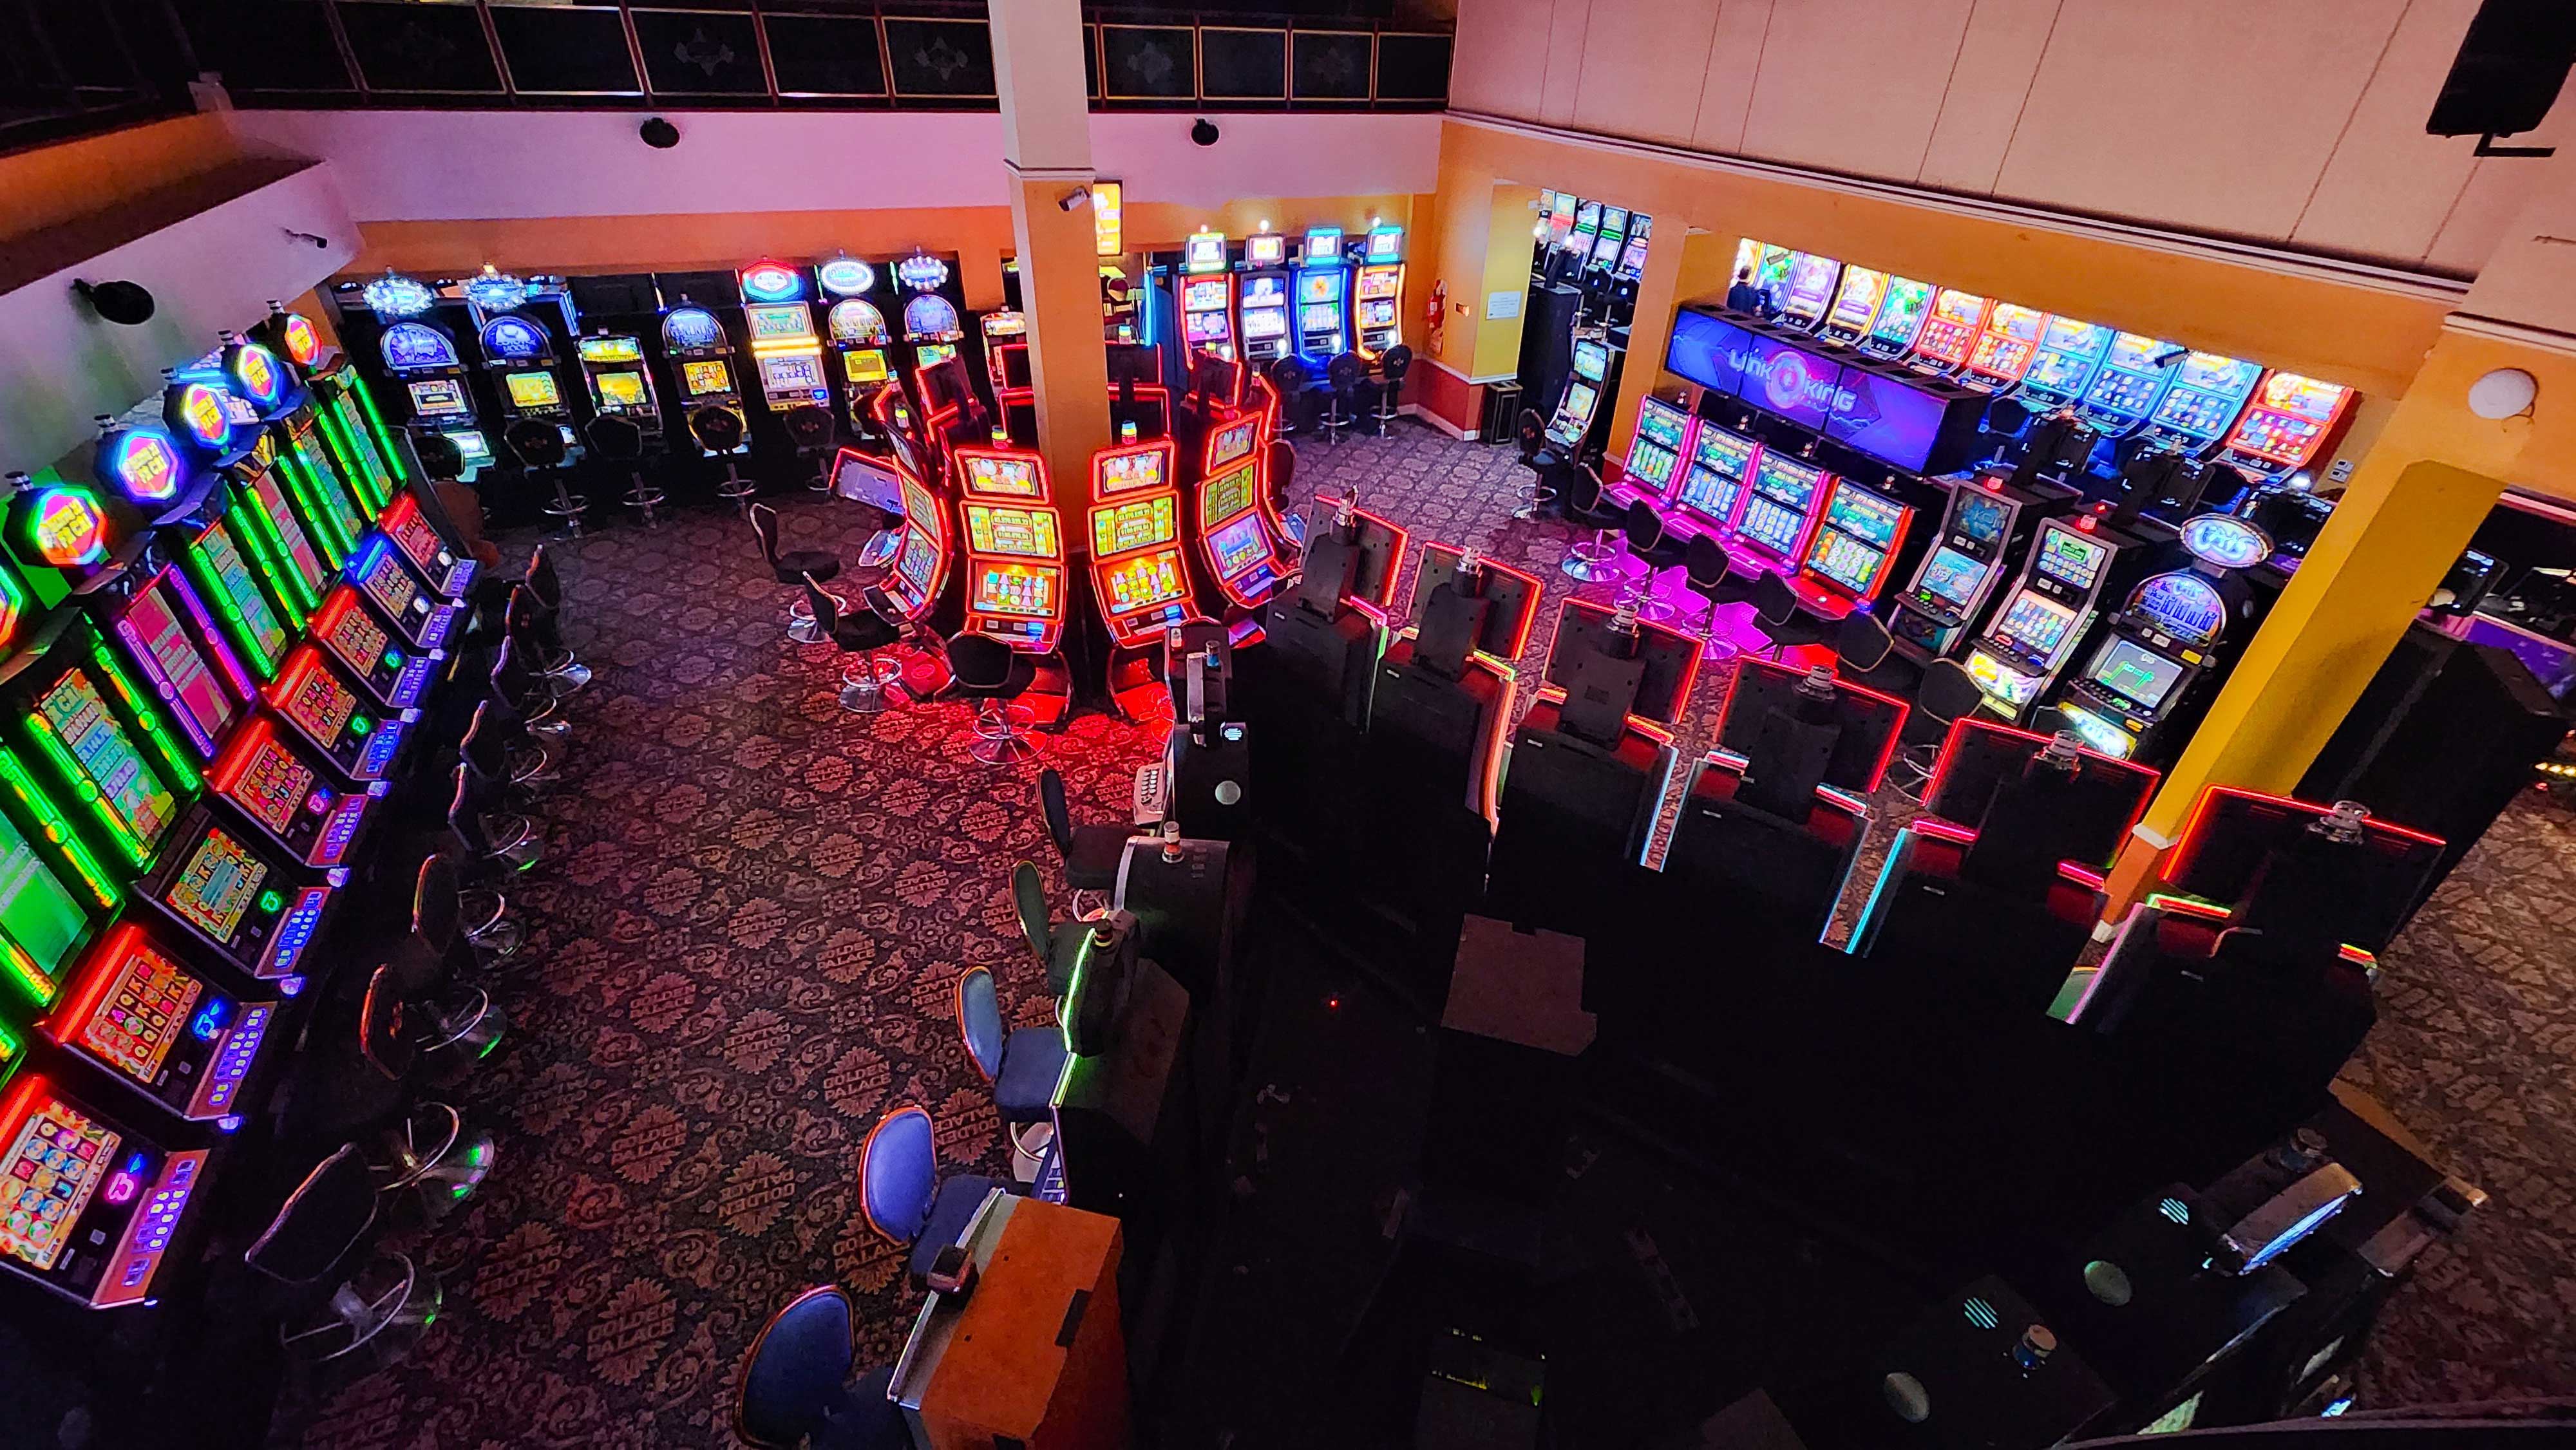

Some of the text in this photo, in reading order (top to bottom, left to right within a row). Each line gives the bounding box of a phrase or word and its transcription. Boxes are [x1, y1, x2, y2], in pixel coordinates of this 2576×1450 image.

[1095, 782, 1134, 795] GOLDE
[960, 809, 1009, 825] GOLDEN
[961, 816, 1010, 833] PALACE
[895, 878, 949, 896] GOLDEN
[728, 917, 787, 937] GOLDEN
[816, 939, 875, 961] GOLDEN
[817, 948, 875, 970] PALACE
[630, 984, 697, 1008] GOLDEN
[723, 1034, 791, 1058] GOLDEN
[724, 1022, 790, 1048] PALACE
[824, 1061, 890, 1088] GOLDEN
[825, 1074, 891, 1101] PALACE
[612, 1123, 687, 1152] GOLDEN
[719, 1169, 794, 1202] PALACE
[718, 1183, 795, 1217] GOLDEN
[588, 1299, 676, 1342] GOLDEN
